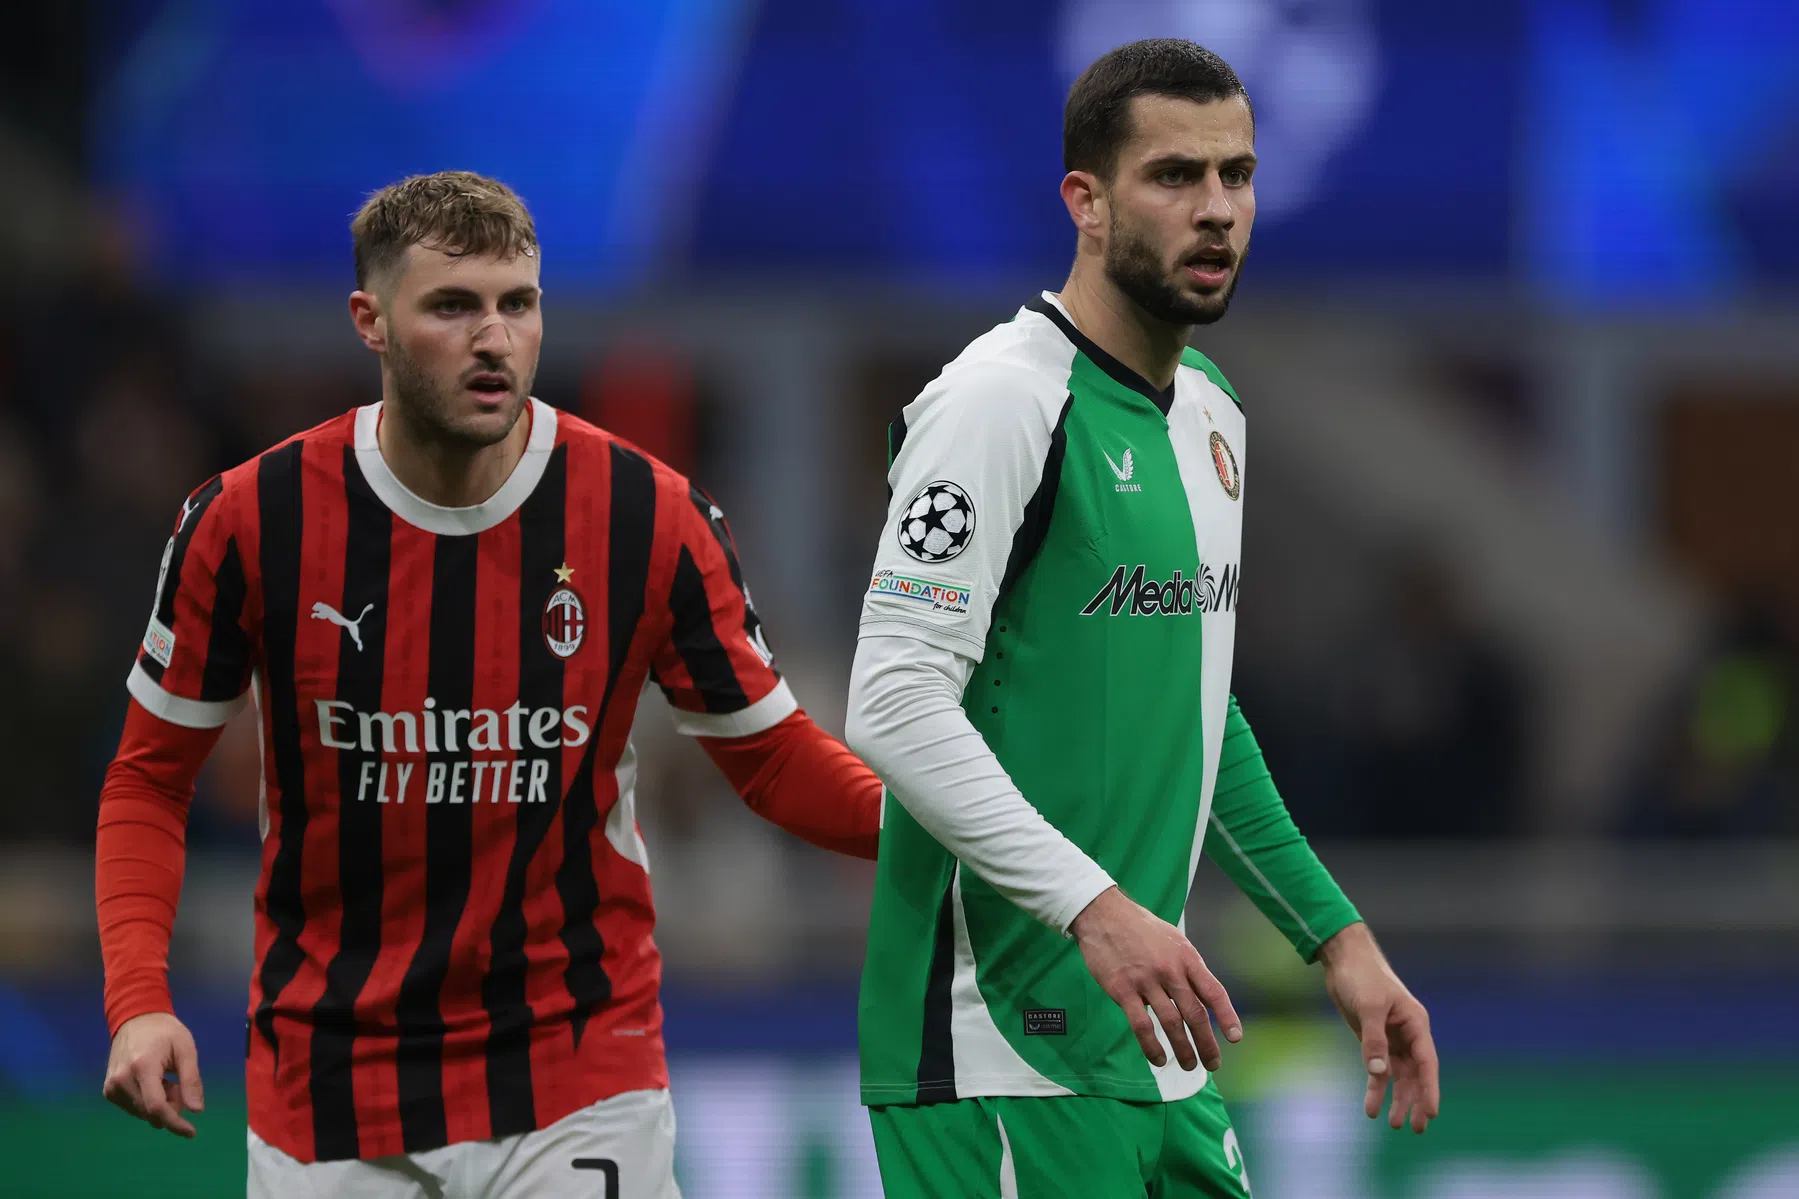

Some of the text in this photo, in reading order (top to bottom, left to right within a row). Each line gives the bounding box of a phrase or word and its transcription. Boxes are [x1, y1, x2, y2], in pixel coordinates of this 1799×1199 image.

[875, 569, 894, 578] UEFA
[1079, 563, 1194, 616] Media
[552, 592, 577, 605] ACM
[932, 602, 967, 614] for children
[554, 643, 575, 651] 1899
[313, 697, 591, 752] Emirates
[357, 759, 549, 804] FLY BETTER
